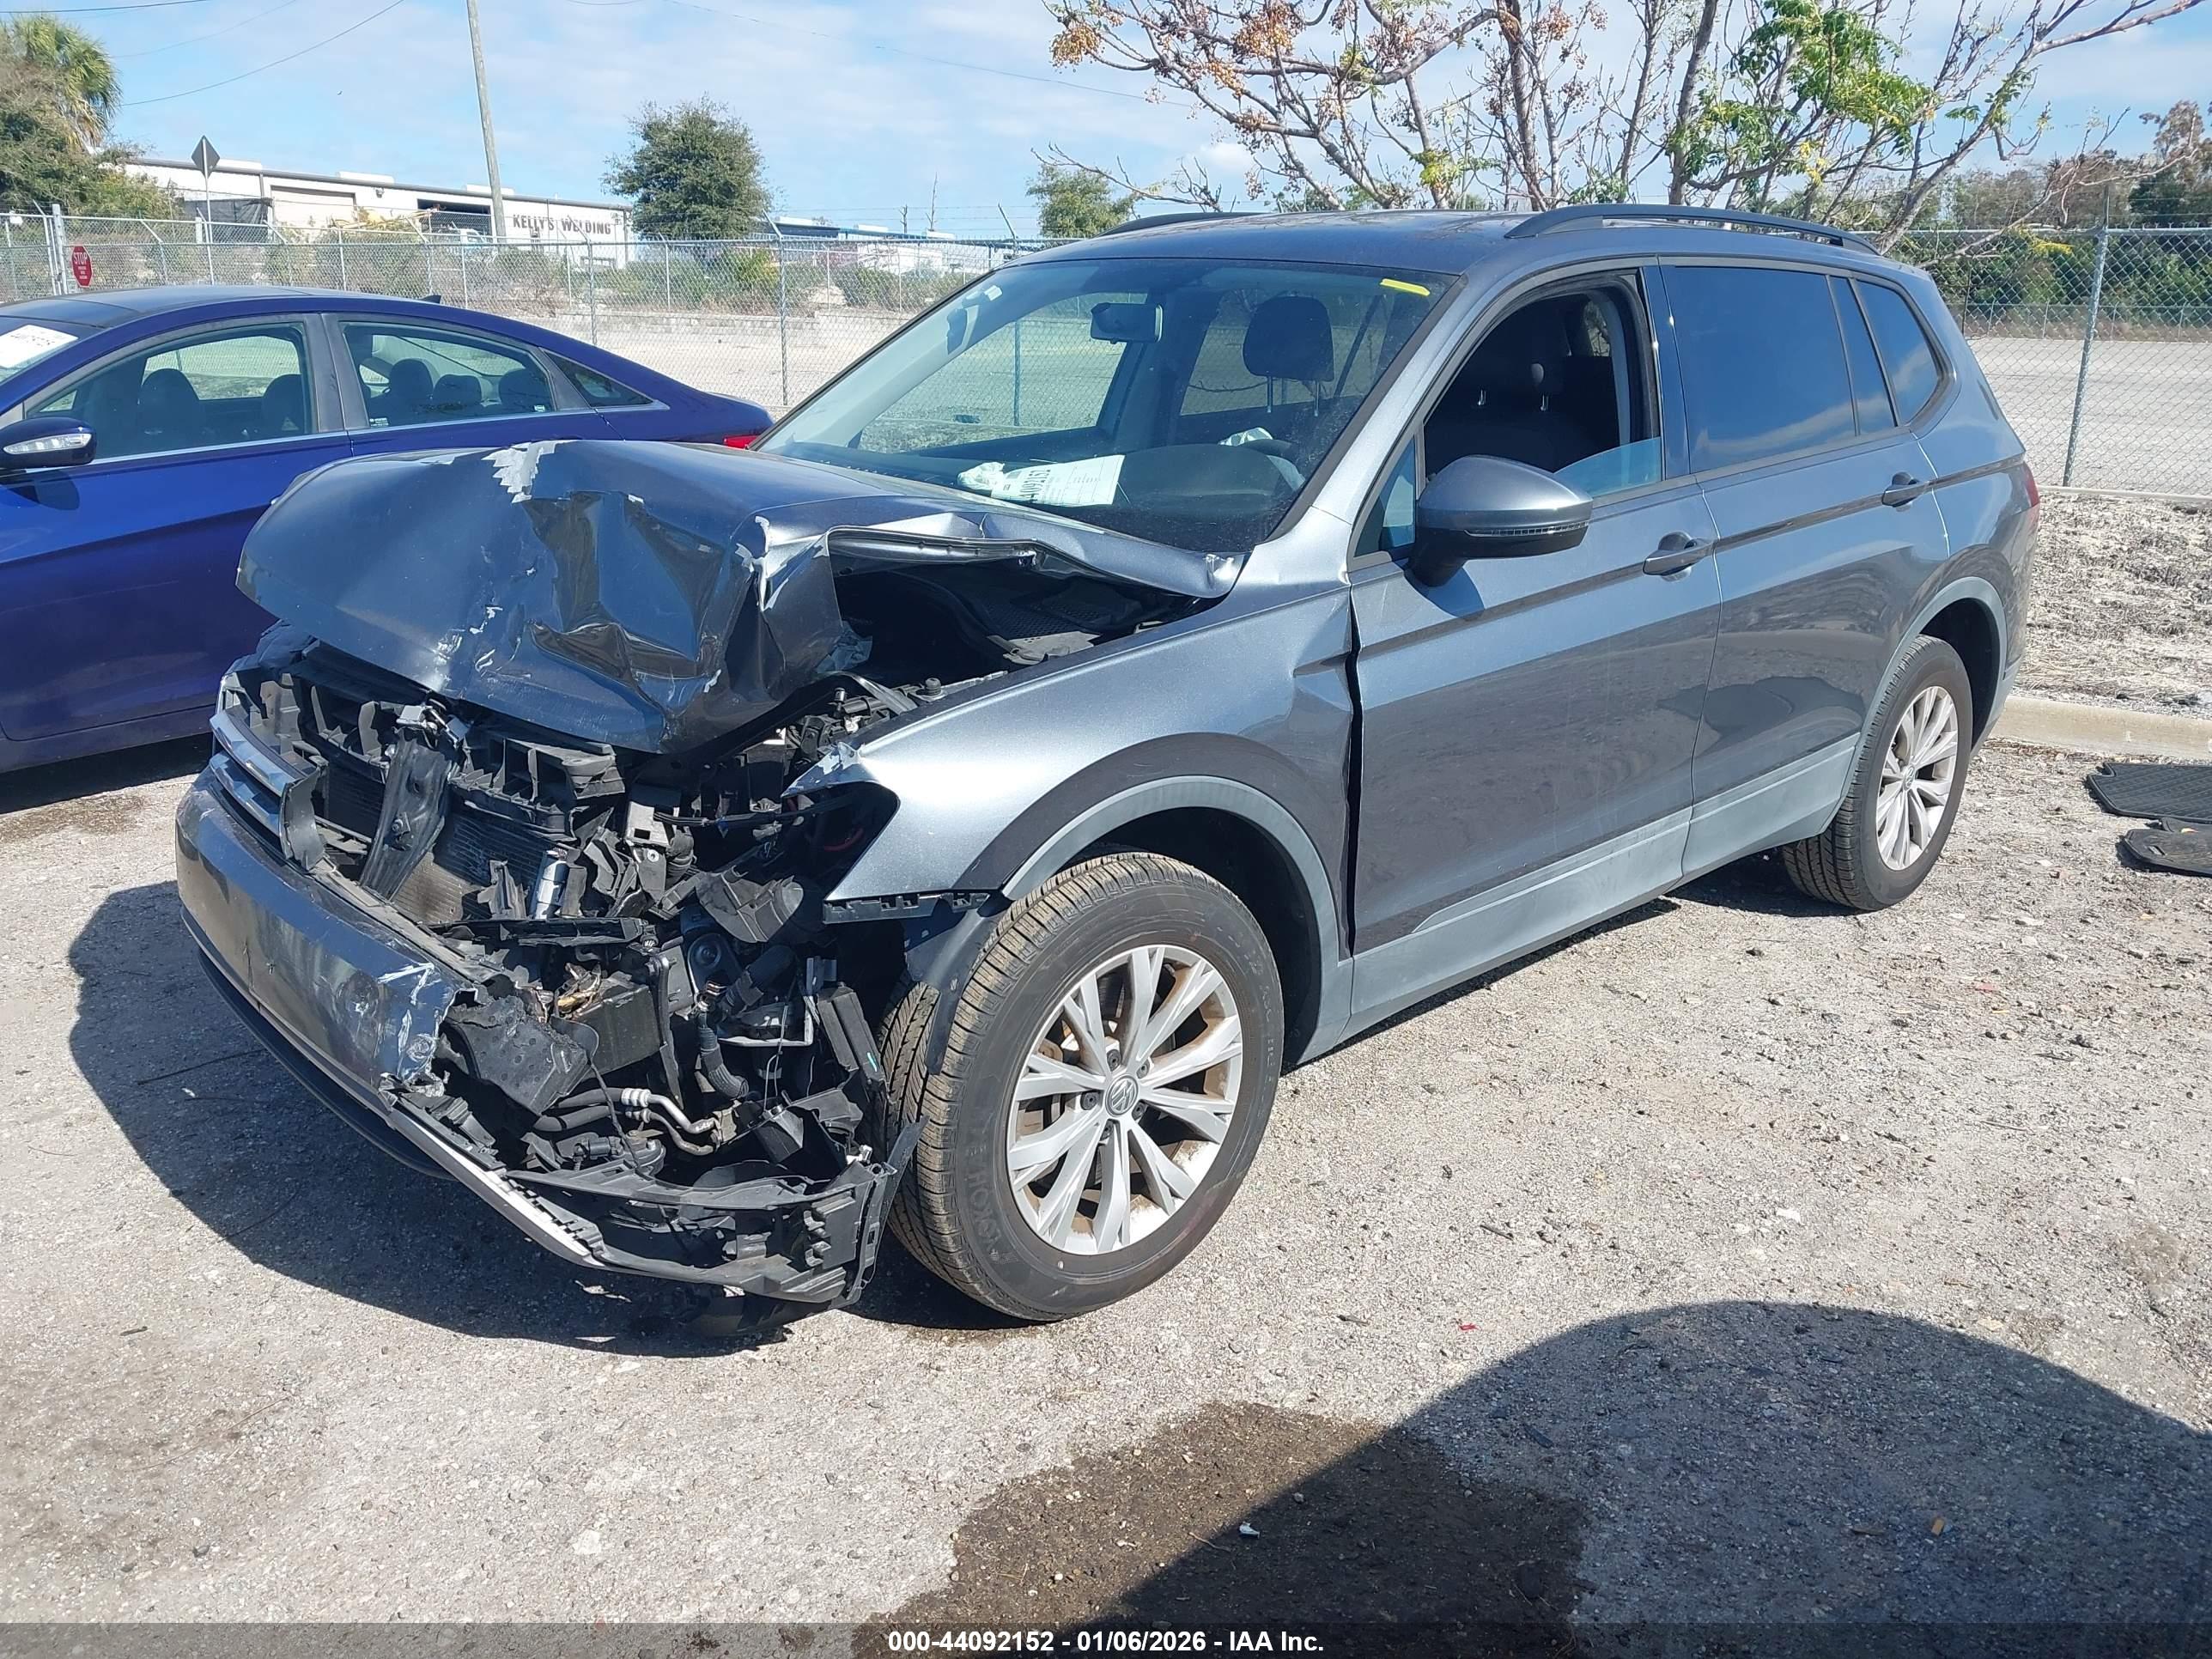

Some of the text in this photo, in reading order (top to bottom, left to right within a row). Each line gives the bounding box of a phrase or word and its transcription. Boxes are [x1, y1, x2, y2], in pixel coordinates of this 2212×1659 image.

[513, 215, 555, 231] KELLY'S
[561, 218, 611, 234] WELDING
[73, 252, 88, 265] STOP
